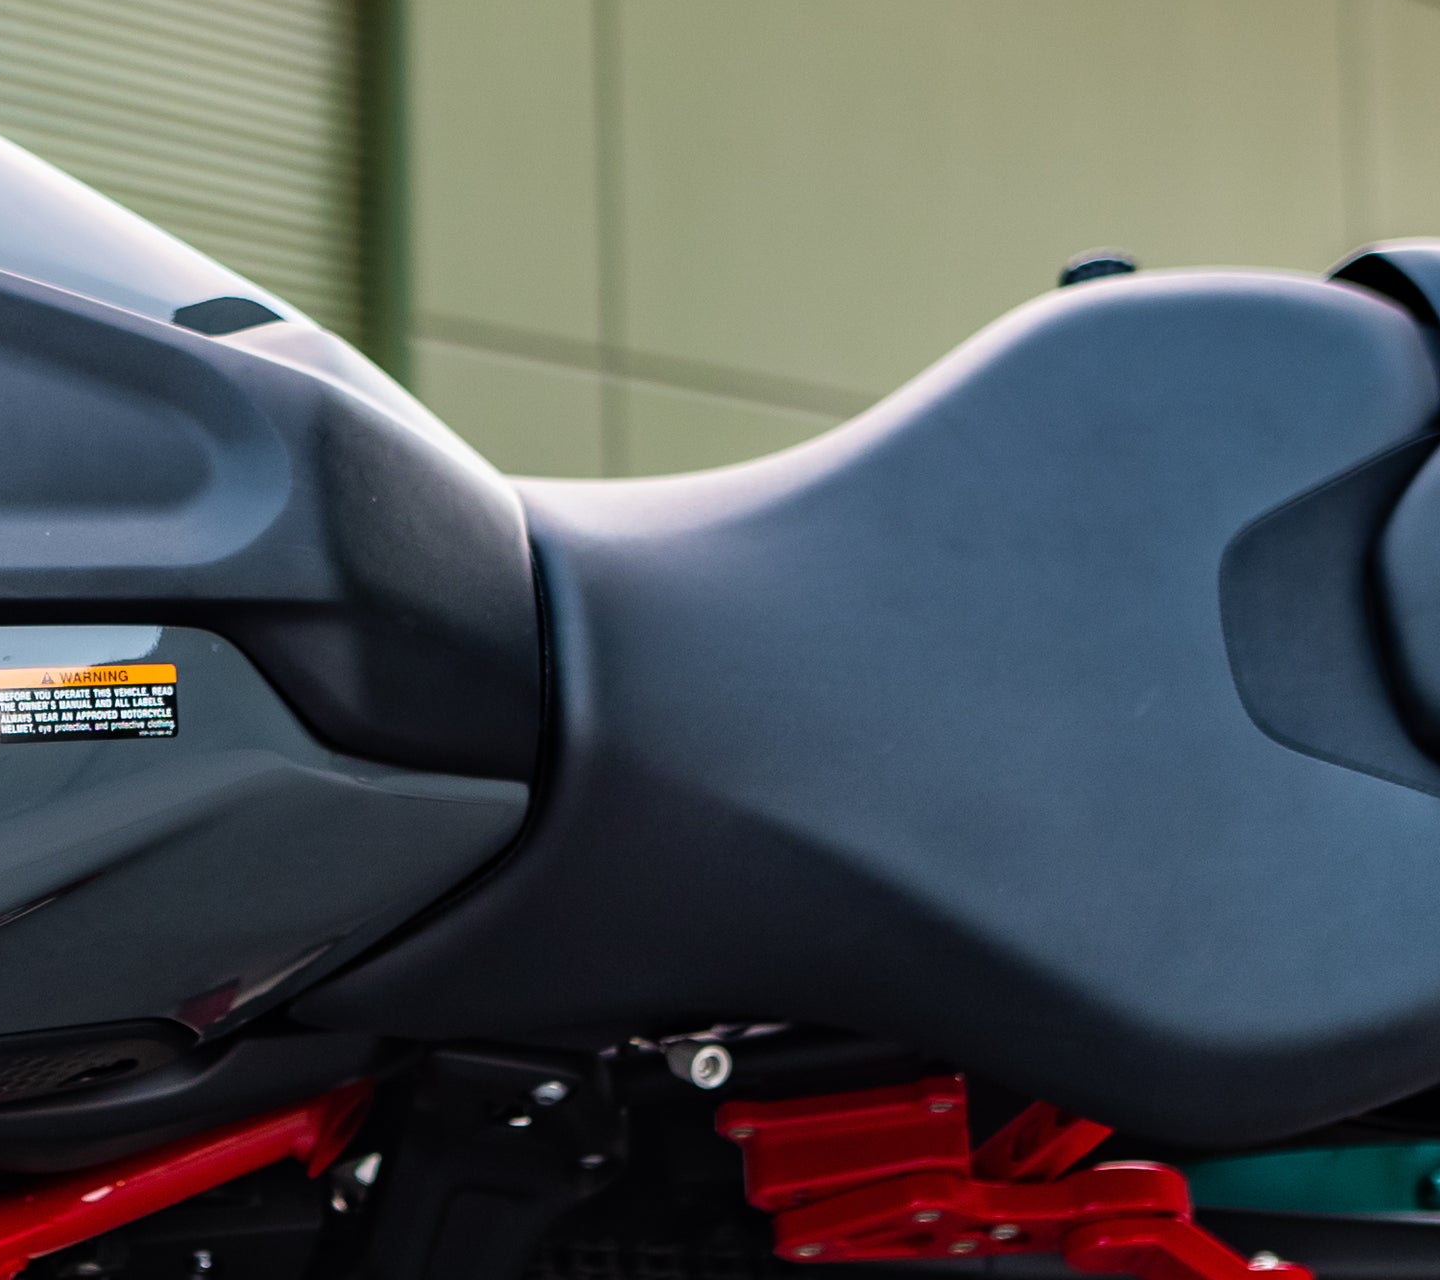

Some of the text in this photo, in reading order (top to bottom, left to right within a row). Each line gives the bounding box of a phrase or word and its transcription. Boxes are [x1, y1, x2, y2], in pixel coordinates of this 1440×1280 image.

[60, 671, 128, 684] WARNING
[0, 691, 31, 702] BEFORE
[34, 690, 50, 700] YOU
[54, 689, 90, 699] OPERATE
[93, 688, 111, 698] THIS
[152, 686, 173, 696] READ
[0, 701, 16, 712] THE
[19, 701, 56, 711] OWNER'S
[60, 700, 92, 709] MANUAL
[95, 698, 112, 708] AND
[115, 698, 130, 707] ALL
[1, 709, 172, 723] ALWAYS WEAR AN APPROVED MOTORCYCLE
[39, 725, 52, 733] eye
[95, 721, 108, 730] and
[111, 721, 144, 730] protective
